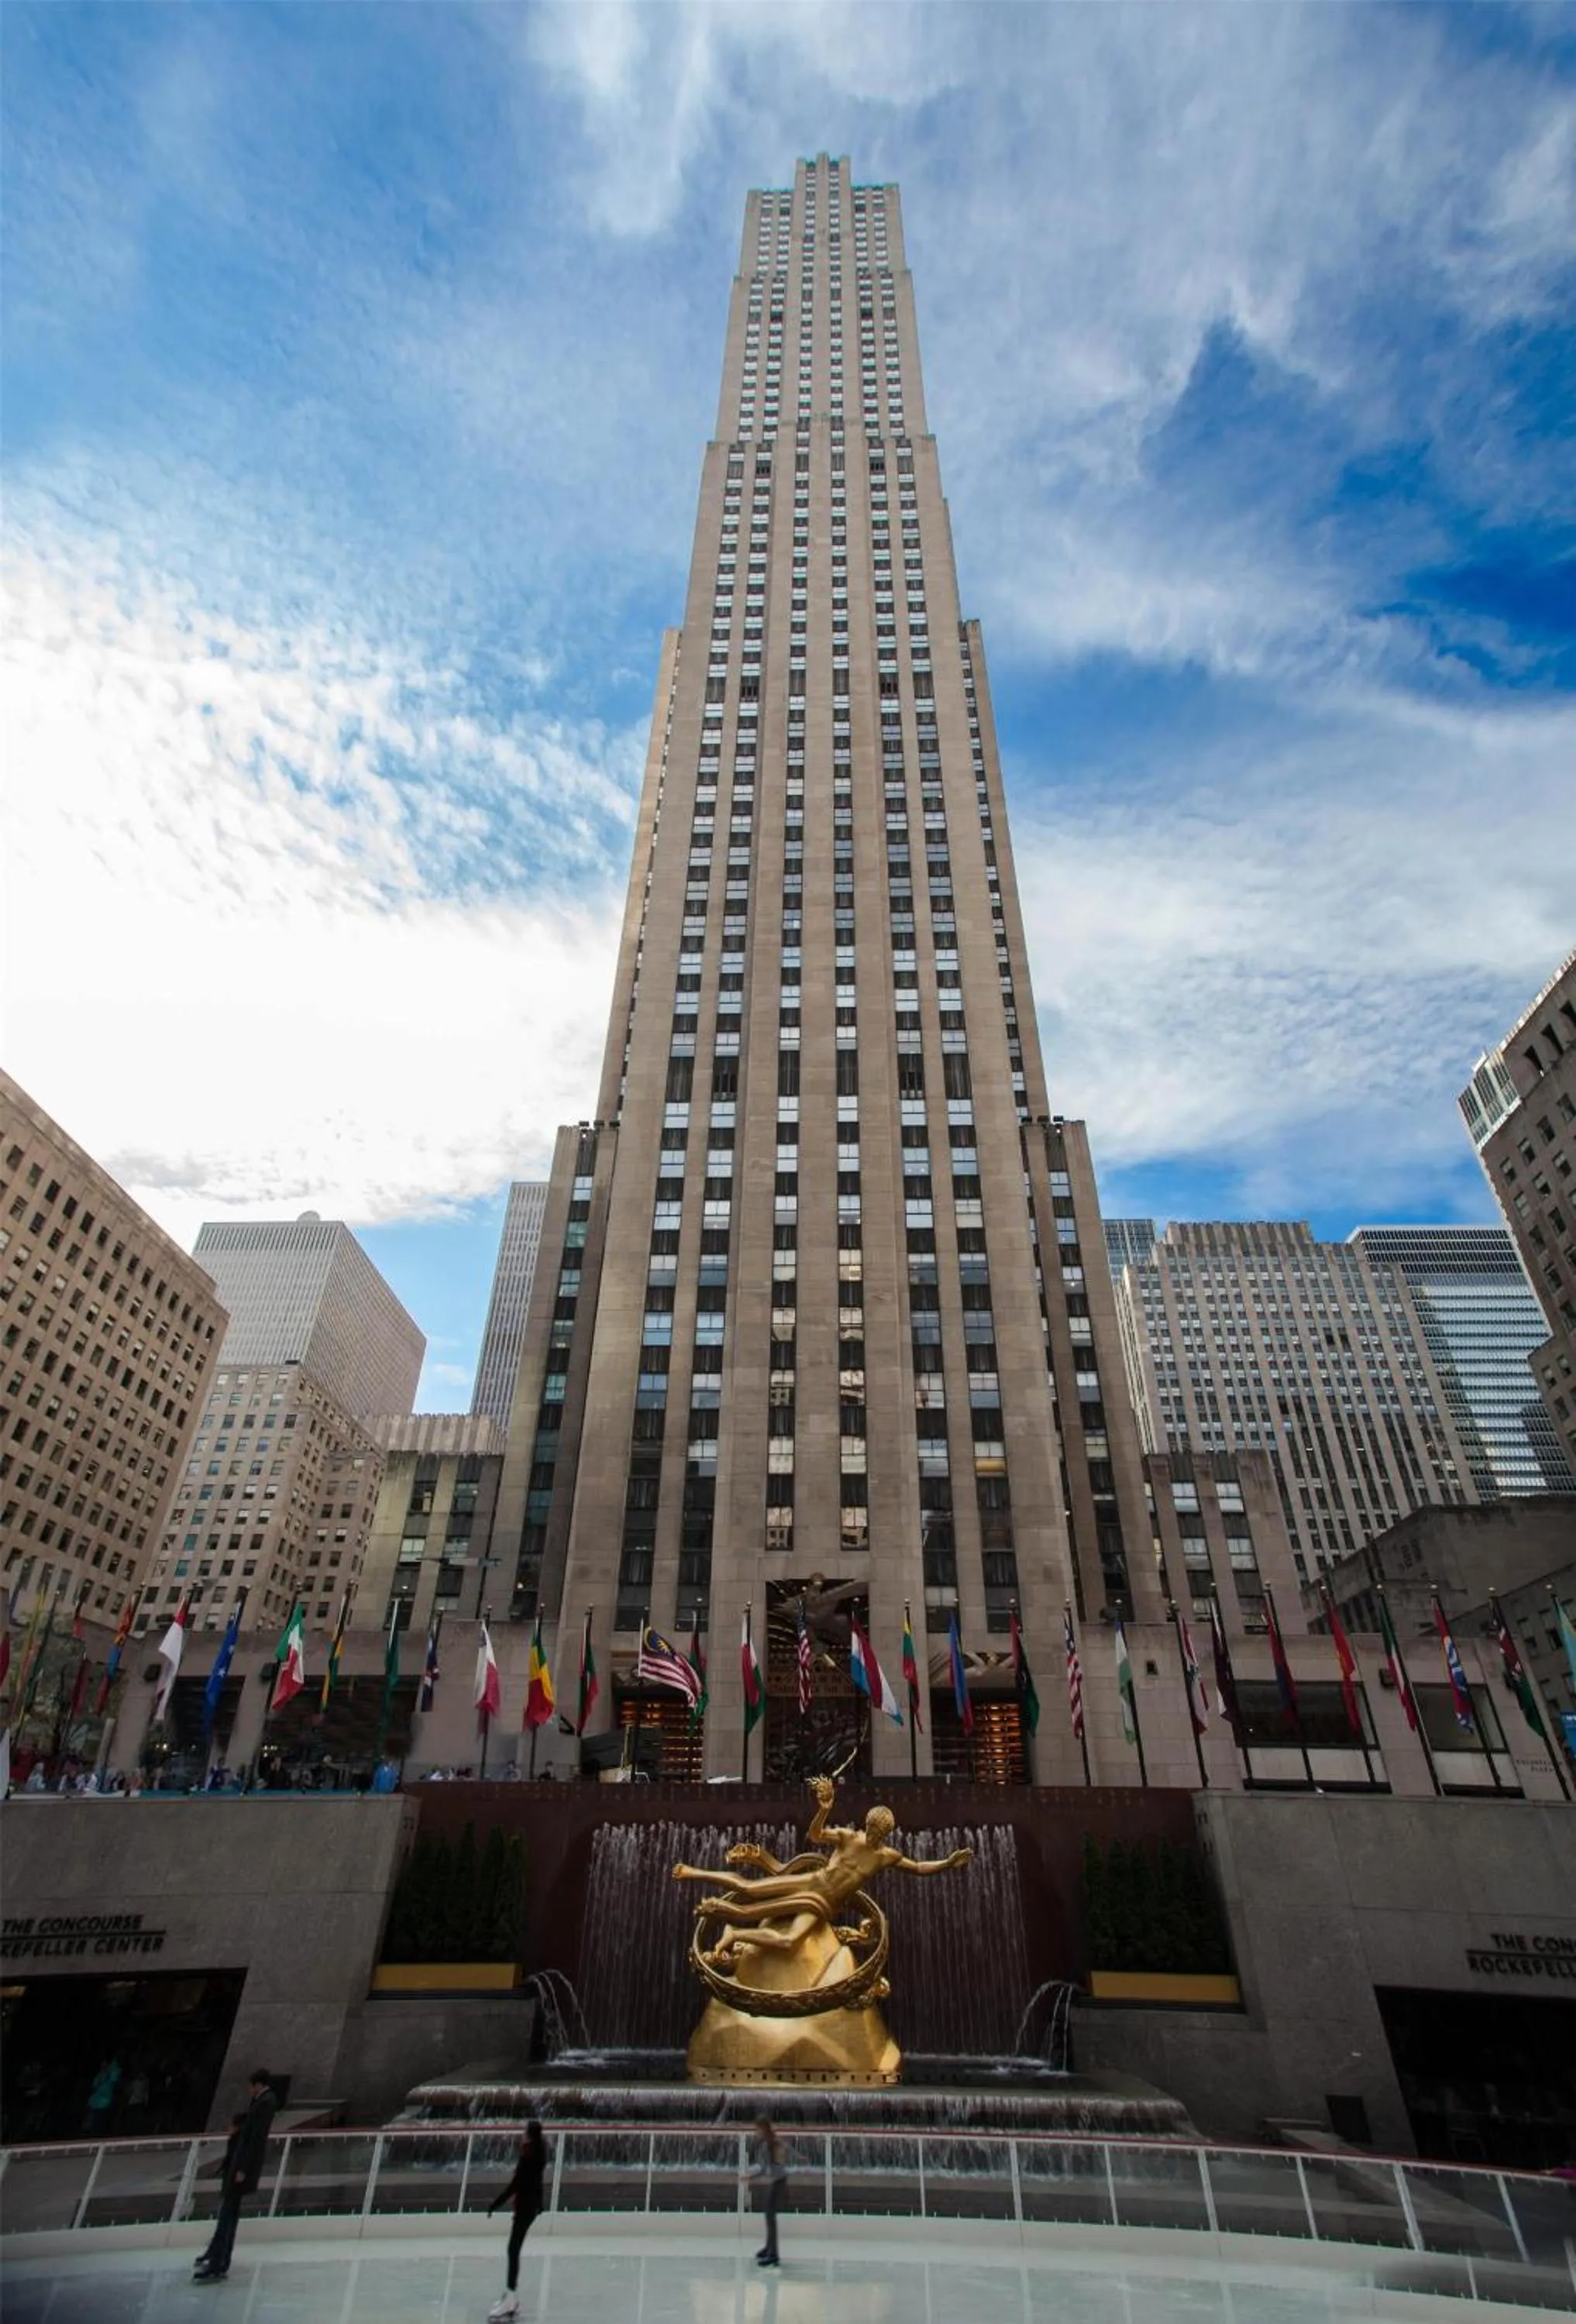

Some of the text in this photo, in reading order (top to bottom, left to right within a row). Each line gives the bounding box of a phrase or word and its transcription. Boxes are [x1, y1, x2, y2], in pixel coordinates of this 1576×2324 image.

[2, 1914, 144, 1934] THE CONCOURSE
[94, 1937, 164, 1954] CENTER
[1491, 1934, 1527, 1951] THE
